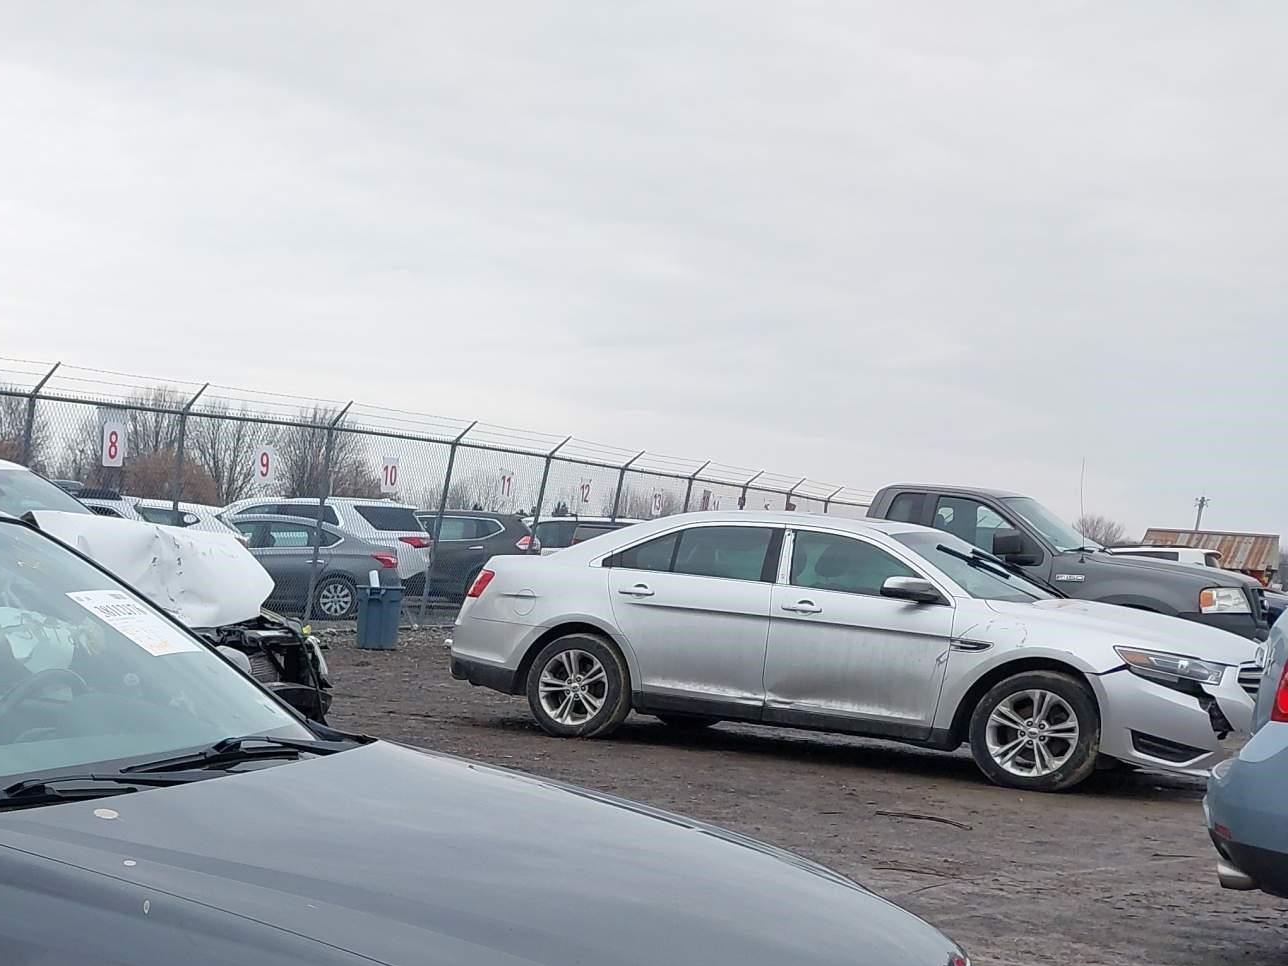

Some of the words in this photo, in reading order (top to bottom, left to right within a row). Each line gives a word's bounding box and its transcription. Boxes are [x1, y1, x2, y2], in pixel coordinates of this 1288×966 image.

[108, 430, 118, 460] 8
[260, 451, 270, 478] 9
[383, 465, 397, 487] 10
[501, 475, 511, 497] 11
[580, 484, 590, 503] 12
